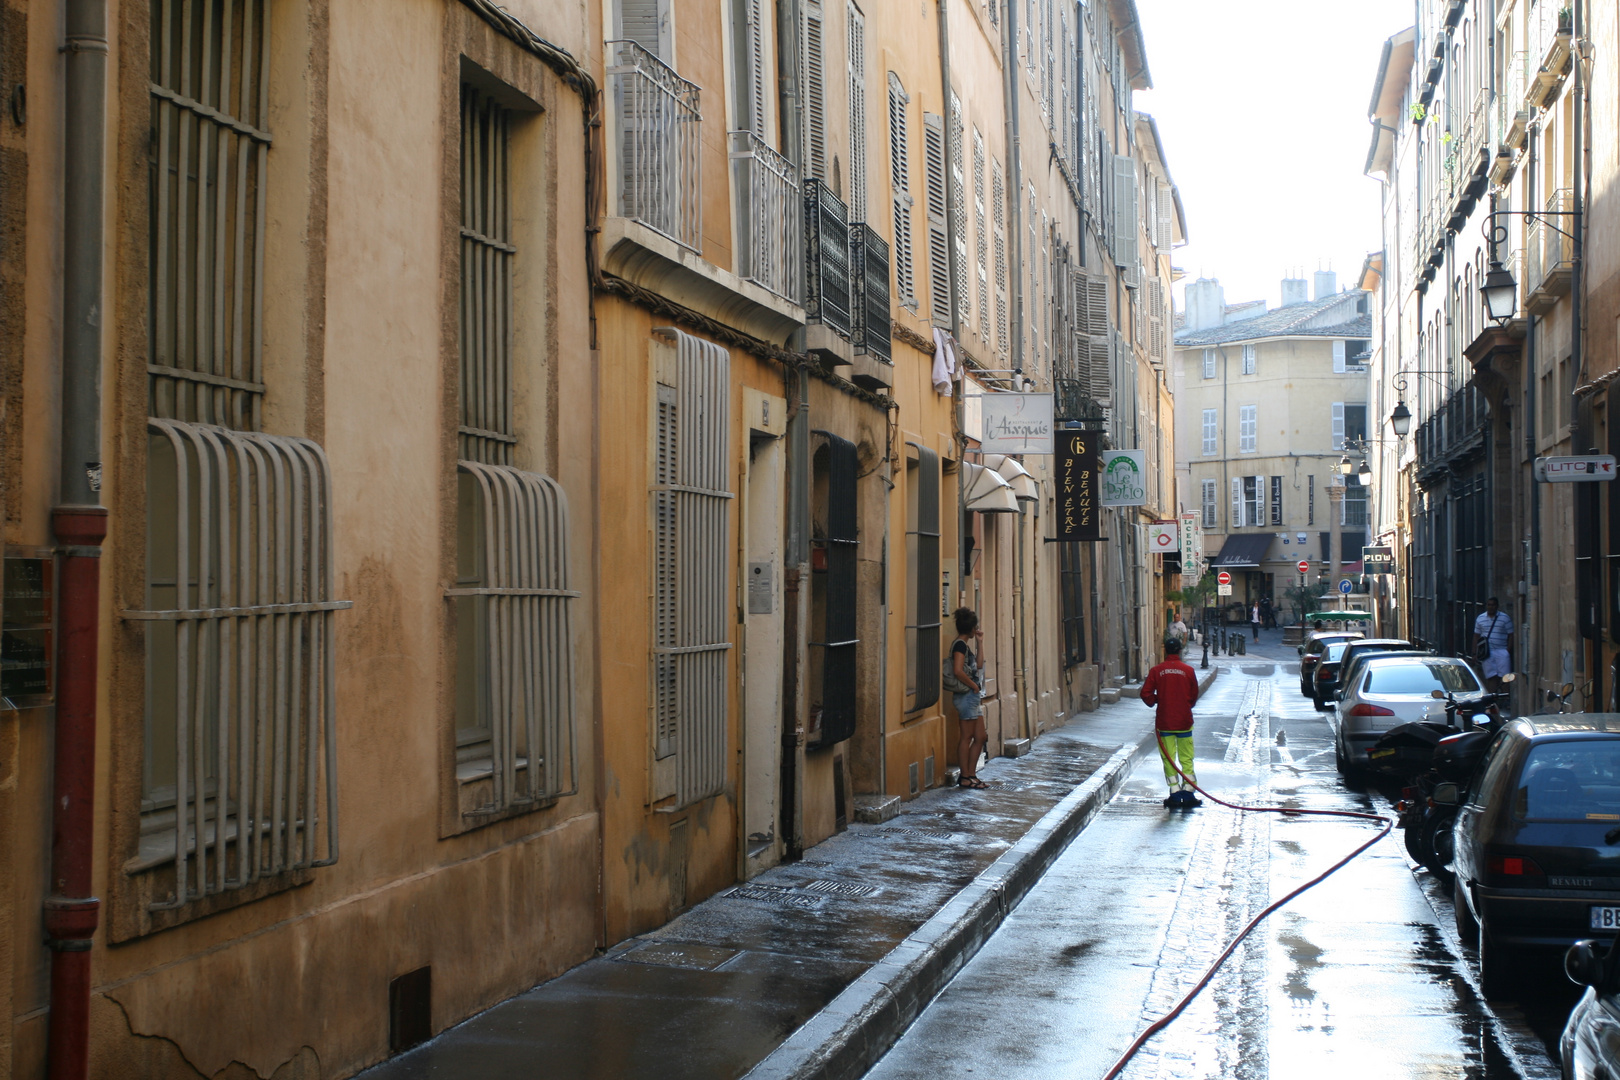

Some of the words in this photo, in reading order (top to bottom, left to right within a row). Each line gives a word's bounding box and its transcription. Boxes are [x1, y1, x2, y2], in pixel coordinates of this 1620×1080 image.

[1063, 458, 1075, 493] BIEN
[1115, 471, 1130, 485] Le
[1080, 470, 1091, 526] BEAUTÉ
[1102, 481, 1144, 501] Patio
[1185, 526, 1193, 560] CEDRE
[1552, 878, 1593, 887] RENAULT
